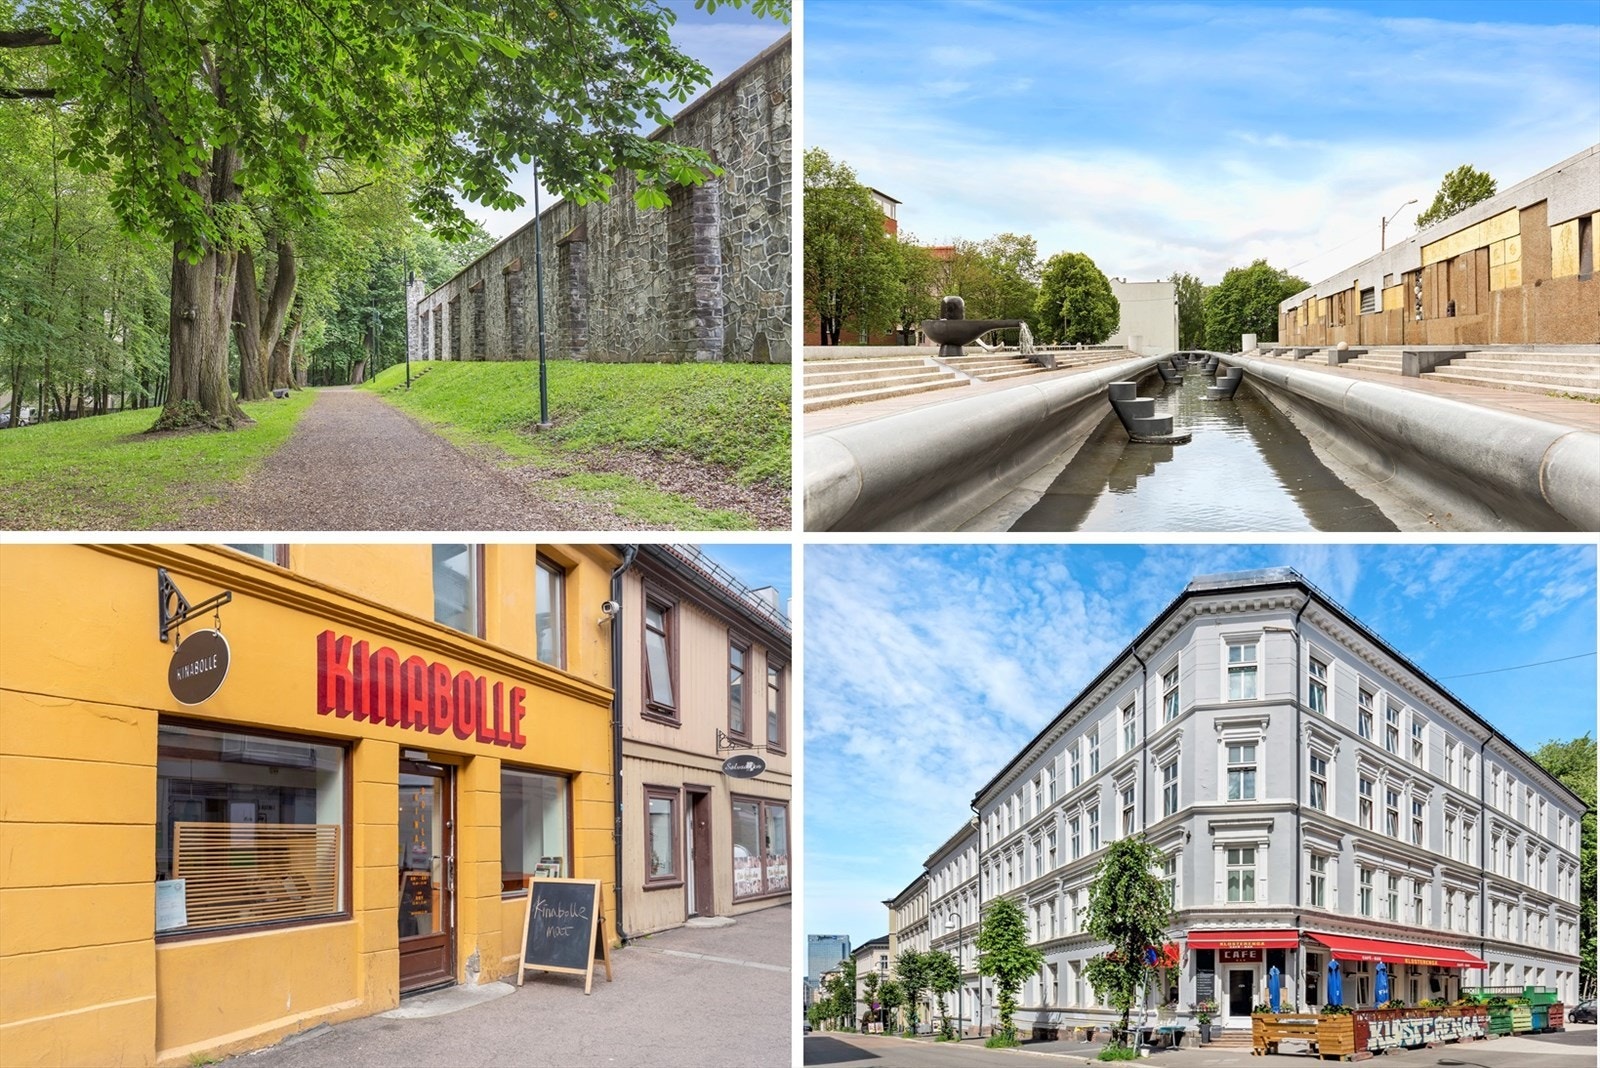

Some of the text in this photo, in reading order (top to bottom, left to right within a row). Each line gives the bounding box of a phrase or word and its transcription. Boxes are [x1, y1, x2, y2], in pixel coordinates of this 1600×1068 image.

[176, 654, 218, 681] KINABOLLE
[317, 629, 527, 750] KINABOLLE
[1224, 950, 1257, 959] CAFE
[1404, 958, 1438, 966] KLOSTERENGA
